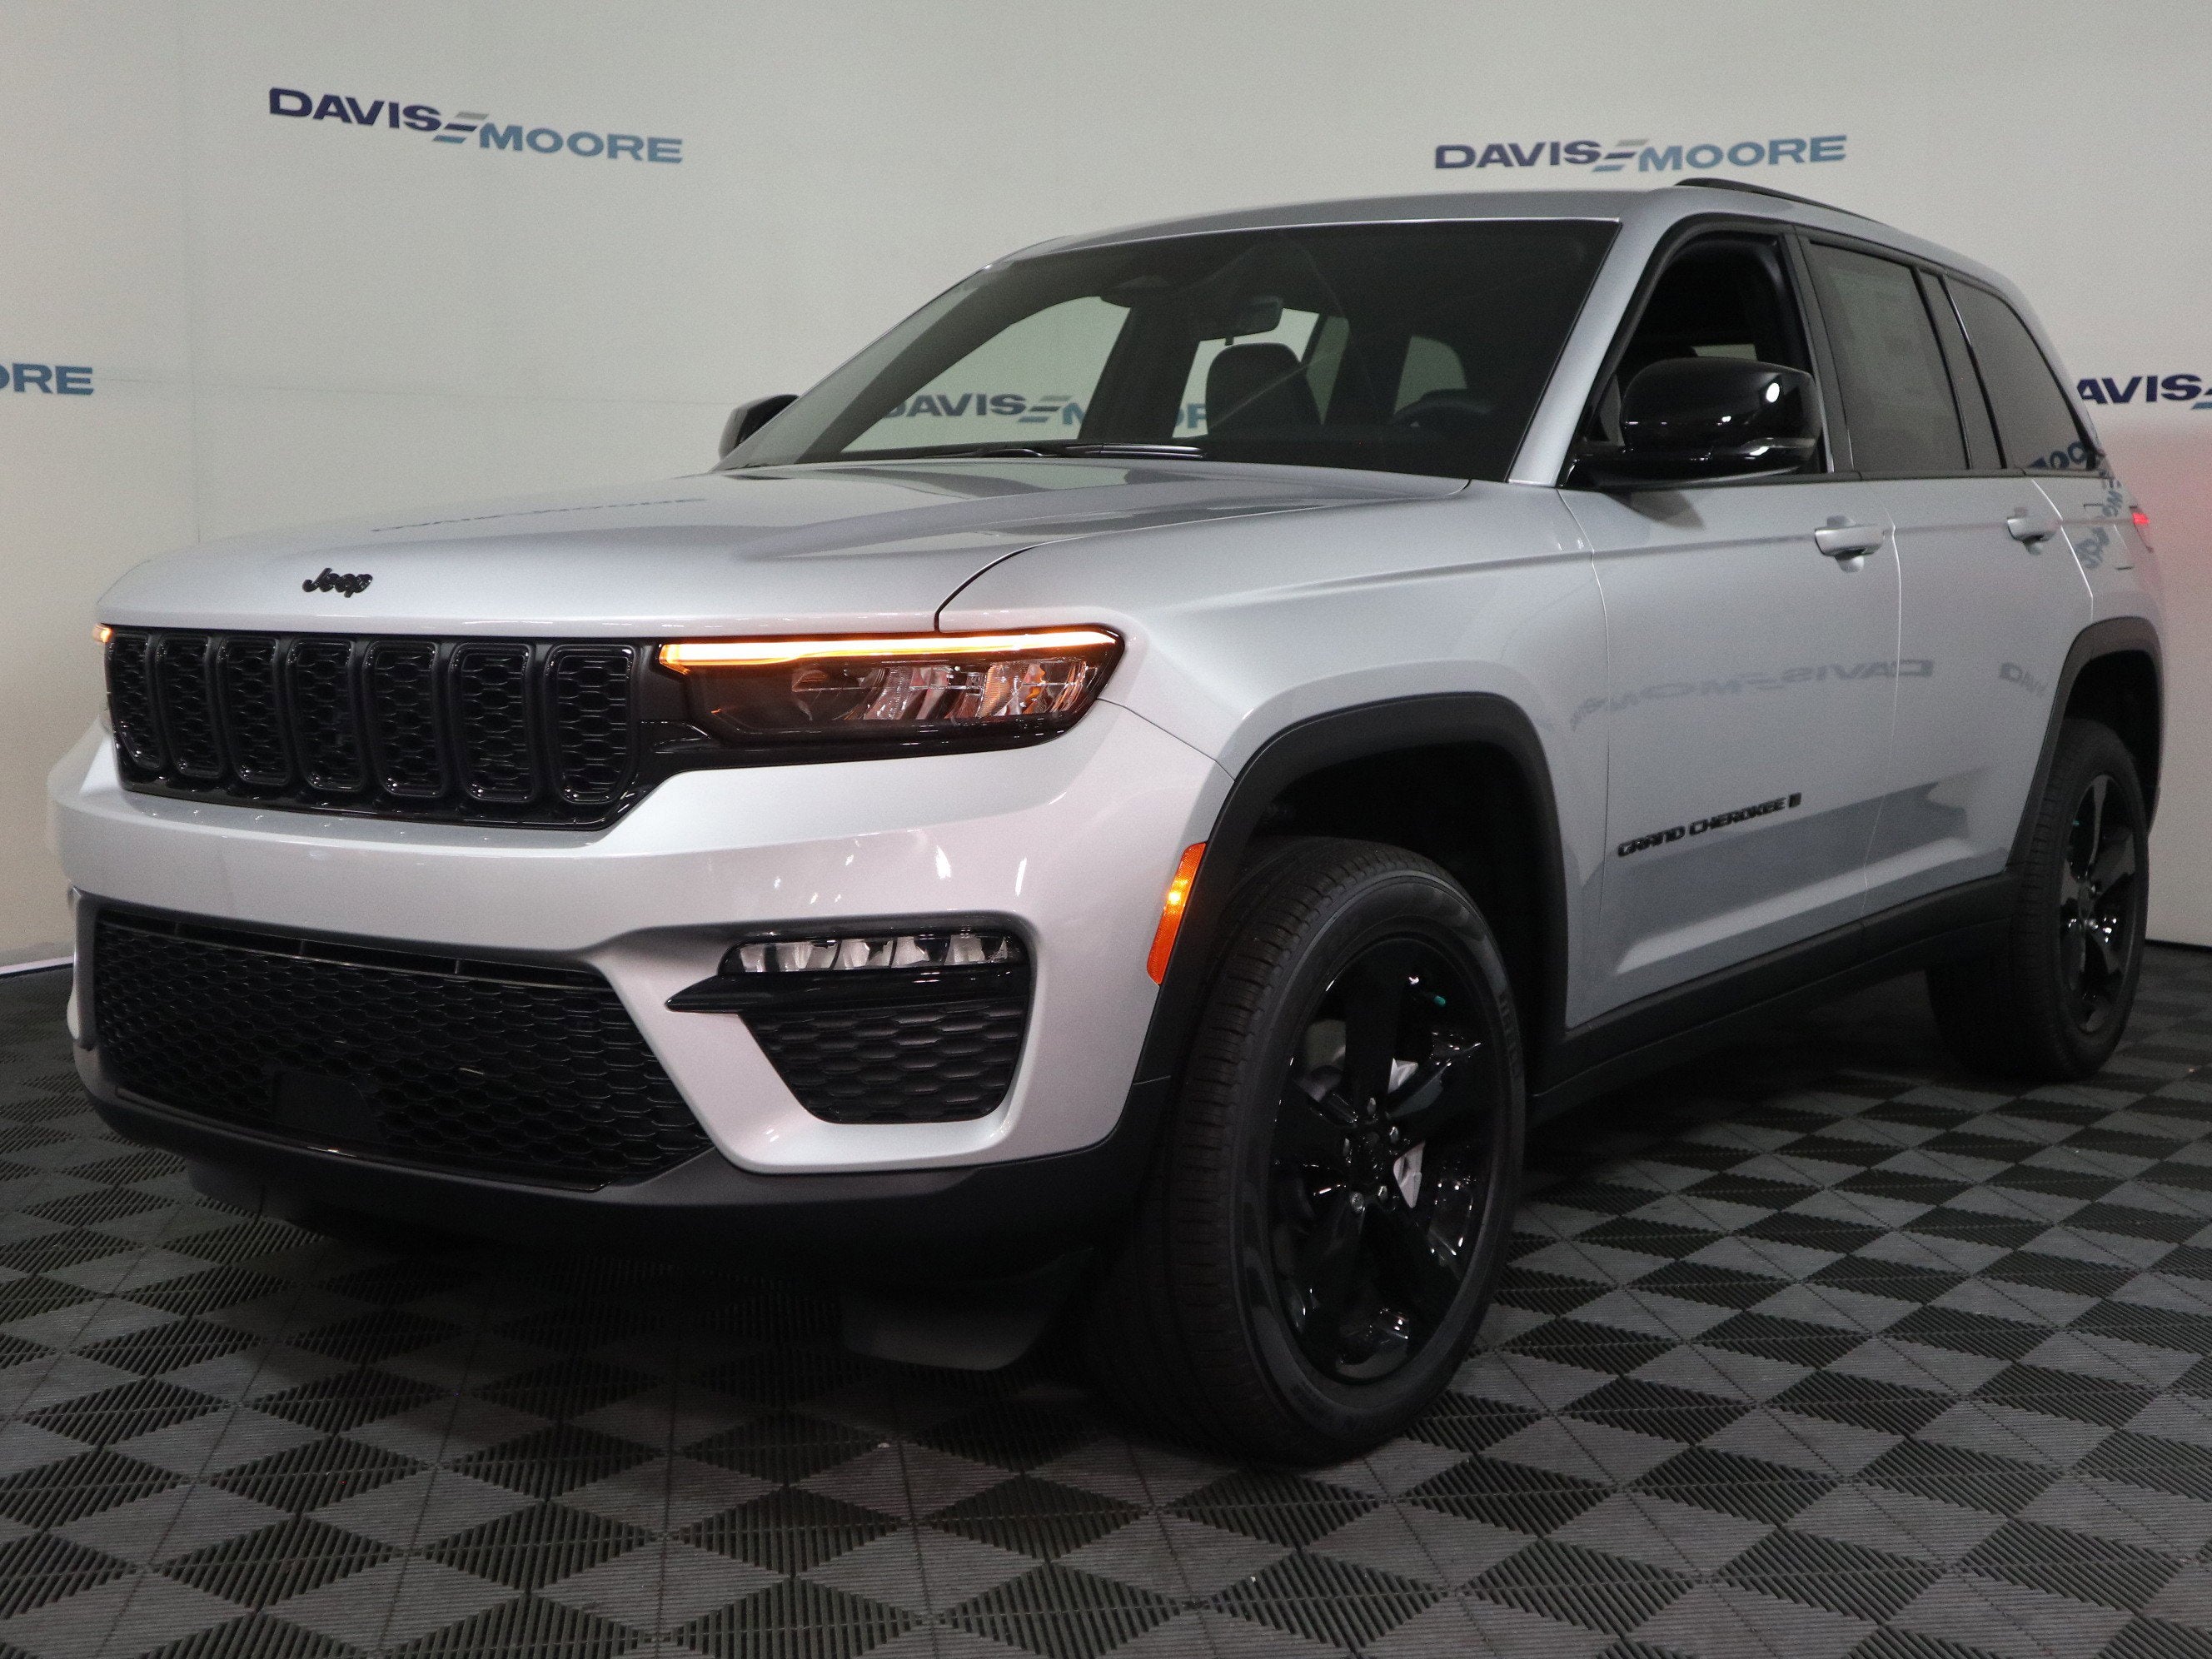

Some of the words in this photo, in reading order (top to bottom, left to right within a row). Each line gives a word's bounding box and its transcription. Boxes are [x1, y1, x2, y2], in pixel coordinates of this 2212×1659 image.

[269, 87, 442, 132] DAVIS
[479, 122, 683, 163] MOORE
[1435, 140, 1602, 168] DAVIS
[1639, 135, 1847, 172] MOORE
[0, 362, 94, 396] RE
[302, 568, 373, 598] Jeep
[1618, 825, 1686, 857] GRAND
[1689, 797, 1787, 836] CHEROKEE
